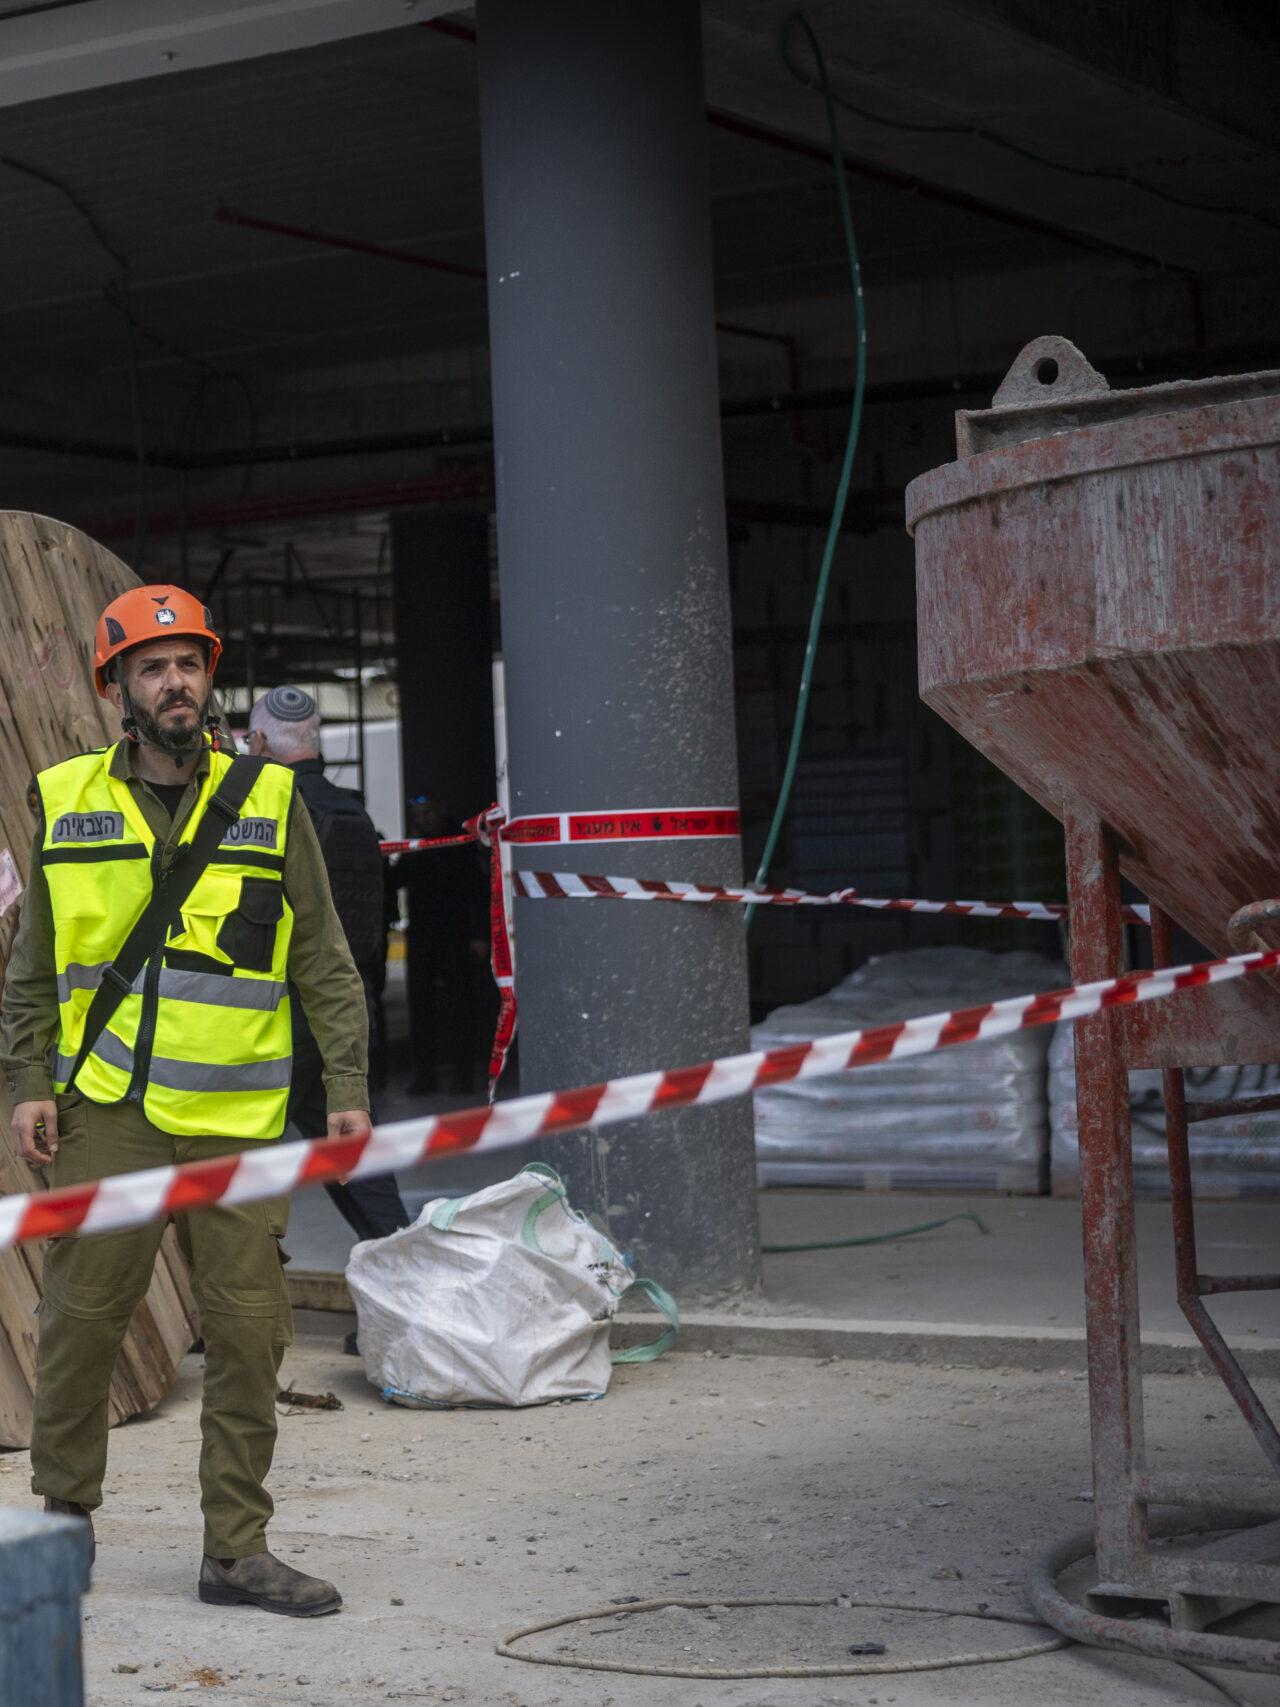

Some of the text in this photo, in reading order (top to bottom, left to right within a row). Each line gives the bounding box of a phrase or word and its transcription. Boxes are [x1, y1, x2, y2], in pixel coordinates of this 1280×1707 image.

[56, 814, 275, 843] המשט הצבאית
[573, 820, 616, 836] מעבר
[620, 819, 642, 836] אין
